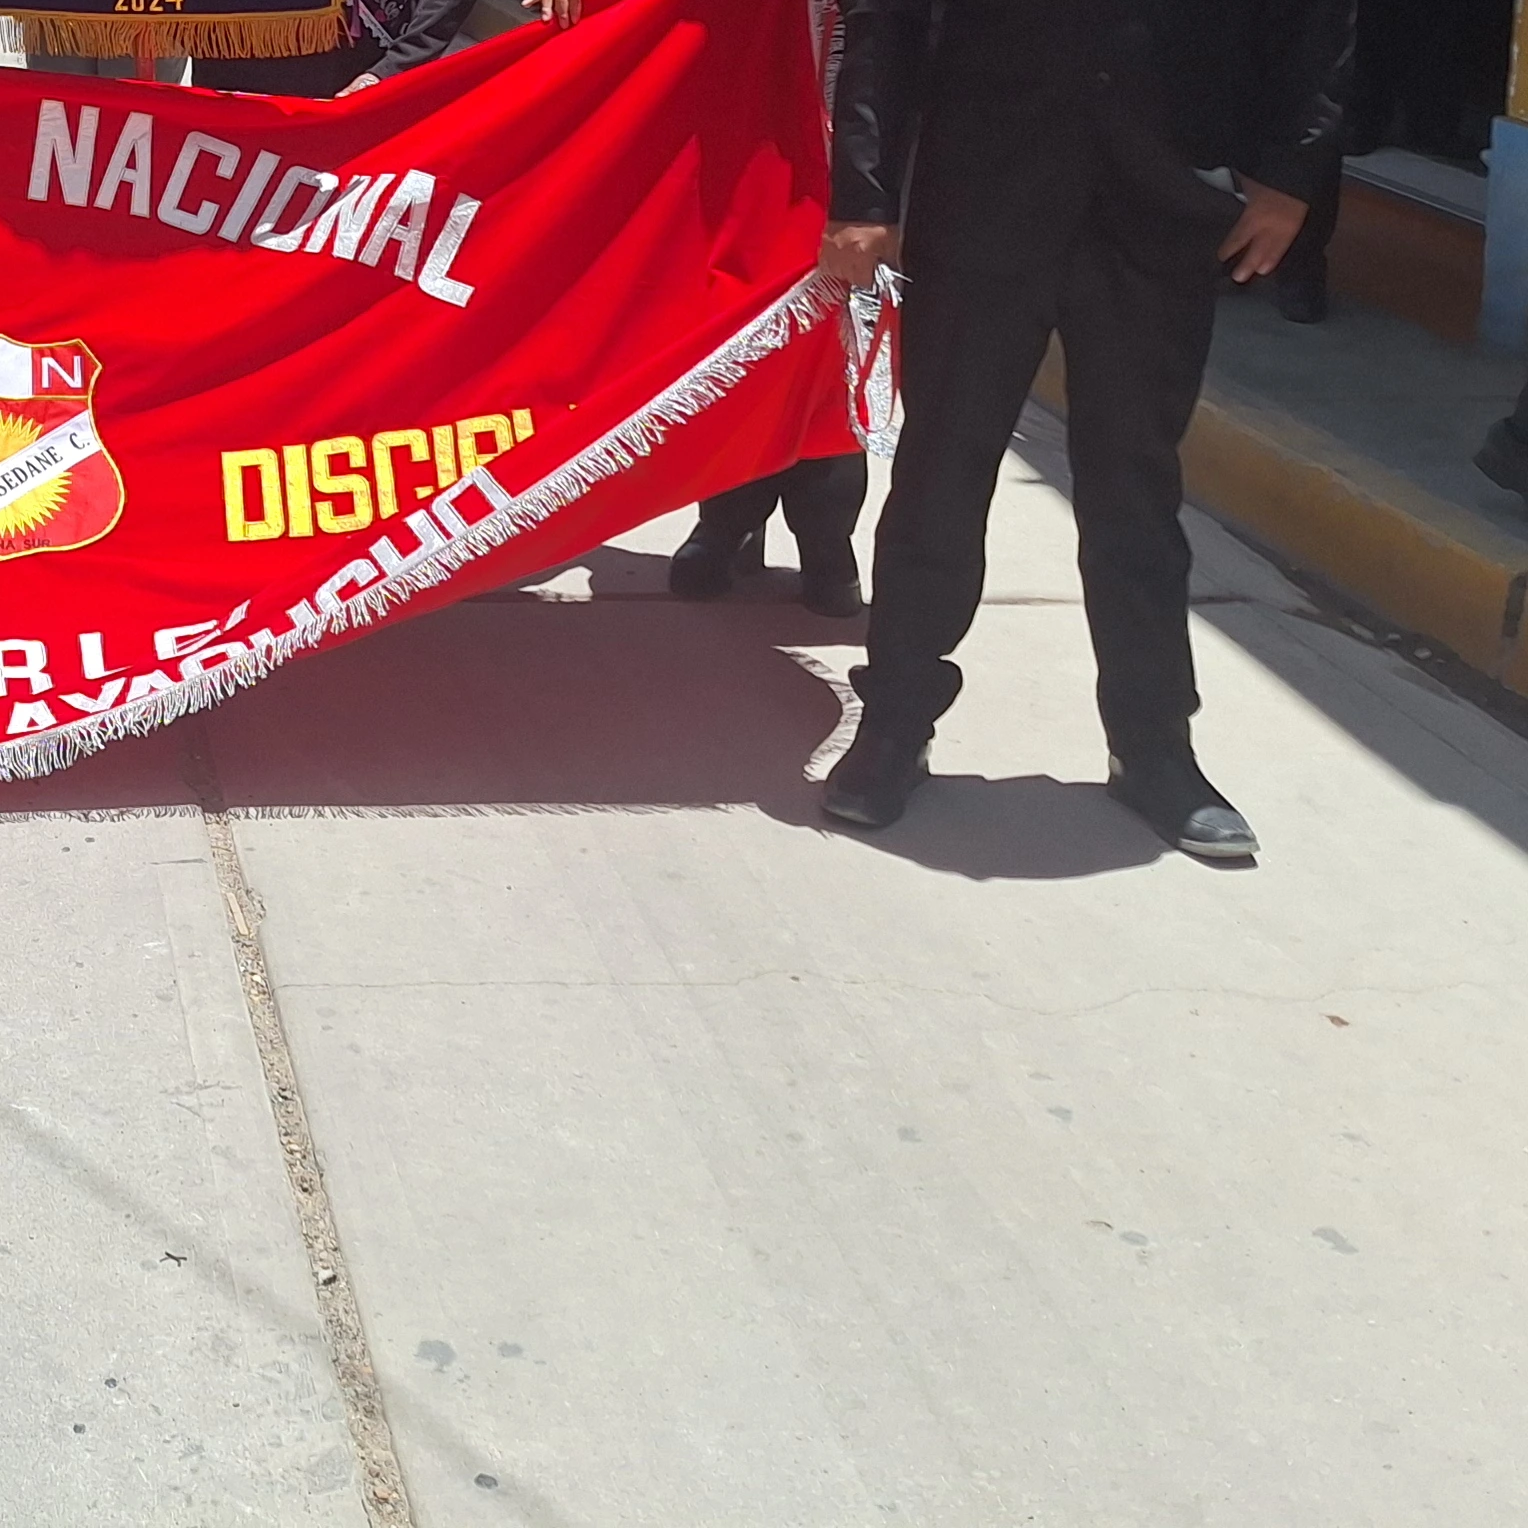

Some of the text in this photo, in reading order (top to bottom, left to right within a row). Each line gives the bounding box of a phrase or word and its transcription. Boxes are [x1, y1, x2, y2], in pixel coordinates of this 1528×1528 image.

[27, 98, 482, 308] NACIONAL
[40, 355, 83, 389] N
[69, 432, 90, 451] C.
[23, 538, 52, 549] SUR
